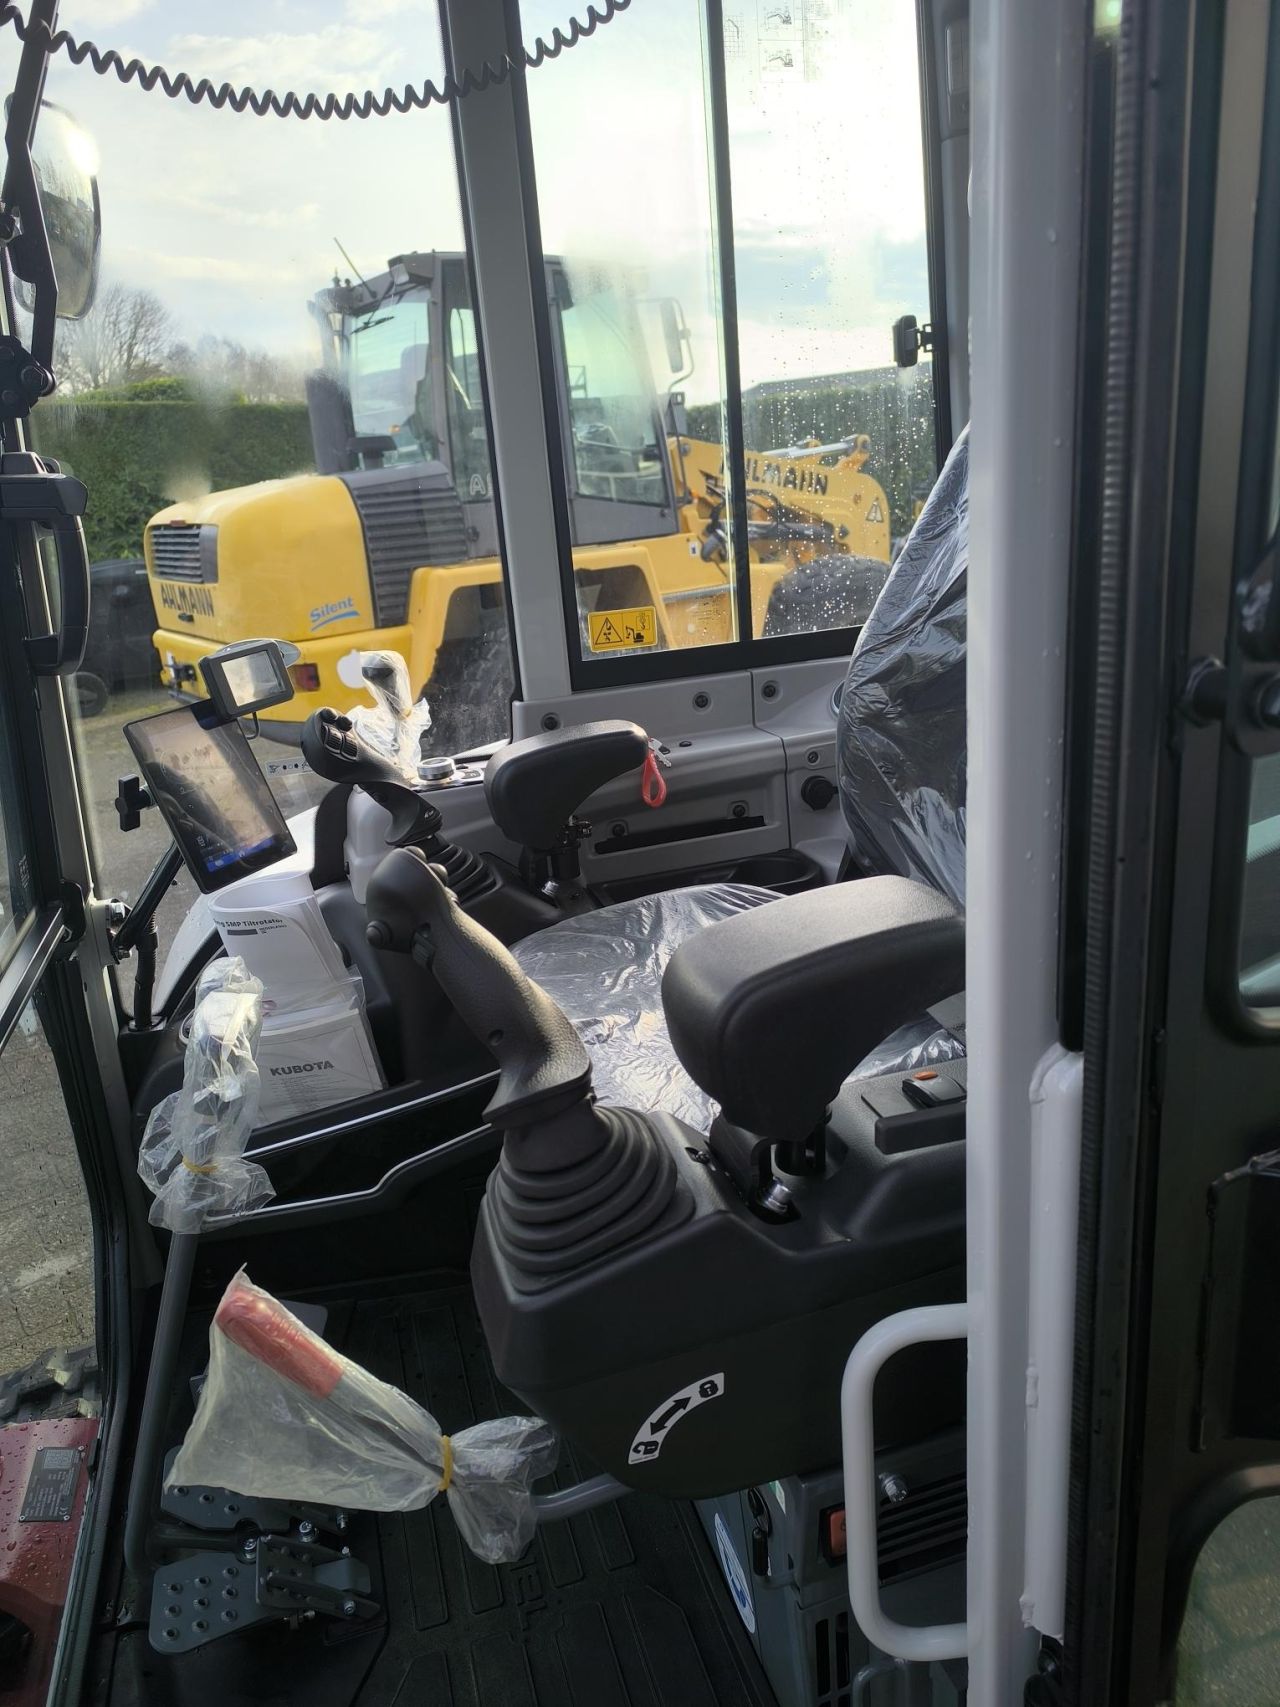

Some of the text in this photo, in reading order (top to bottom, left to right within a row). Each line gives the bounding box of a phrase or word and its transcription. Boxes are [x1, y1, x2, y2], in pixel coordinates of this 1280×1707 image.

[160, 582, 215, 618] AHLMANN
[310, 596, 353, 623] Silent
[269, 1060, 335, 1077] KUBOTA
